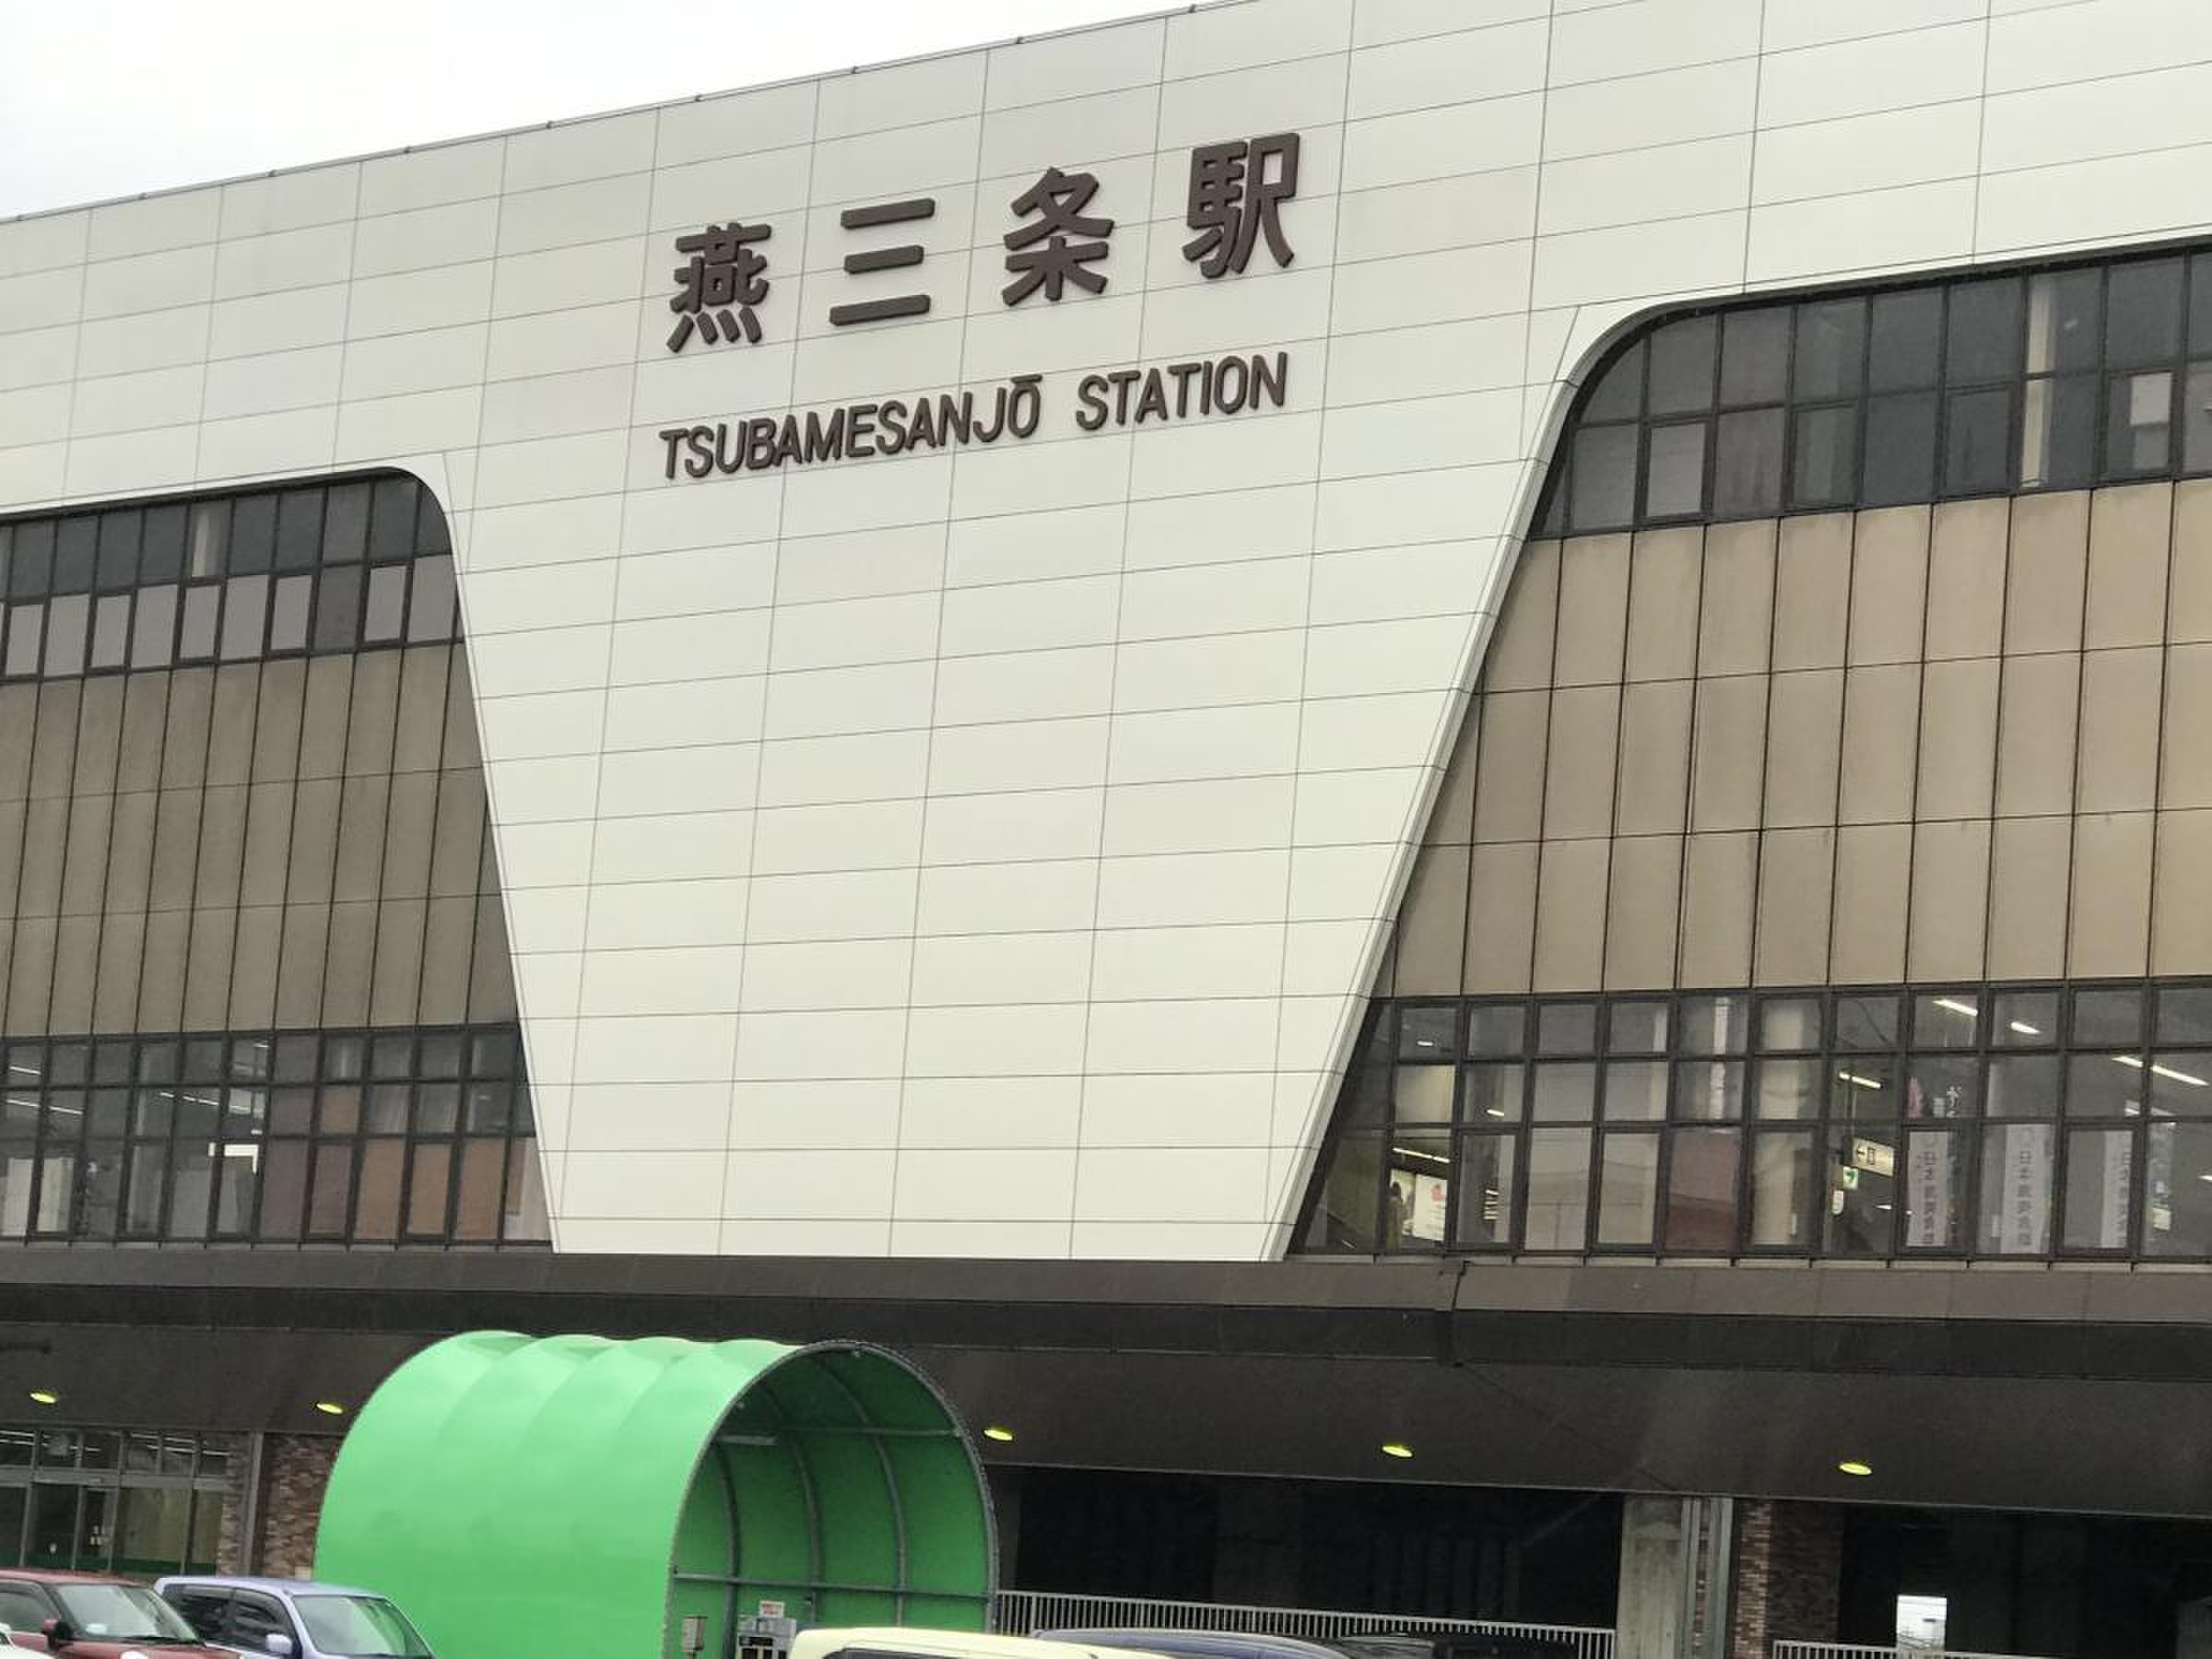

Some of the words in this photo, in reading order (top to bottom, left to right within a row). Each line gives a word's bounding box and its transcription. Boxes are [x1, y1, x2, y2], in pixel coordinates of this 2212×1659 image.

[666, 133, 1300, 353] 燕三条駅
[1077, 352, 1288, 431] STATION
